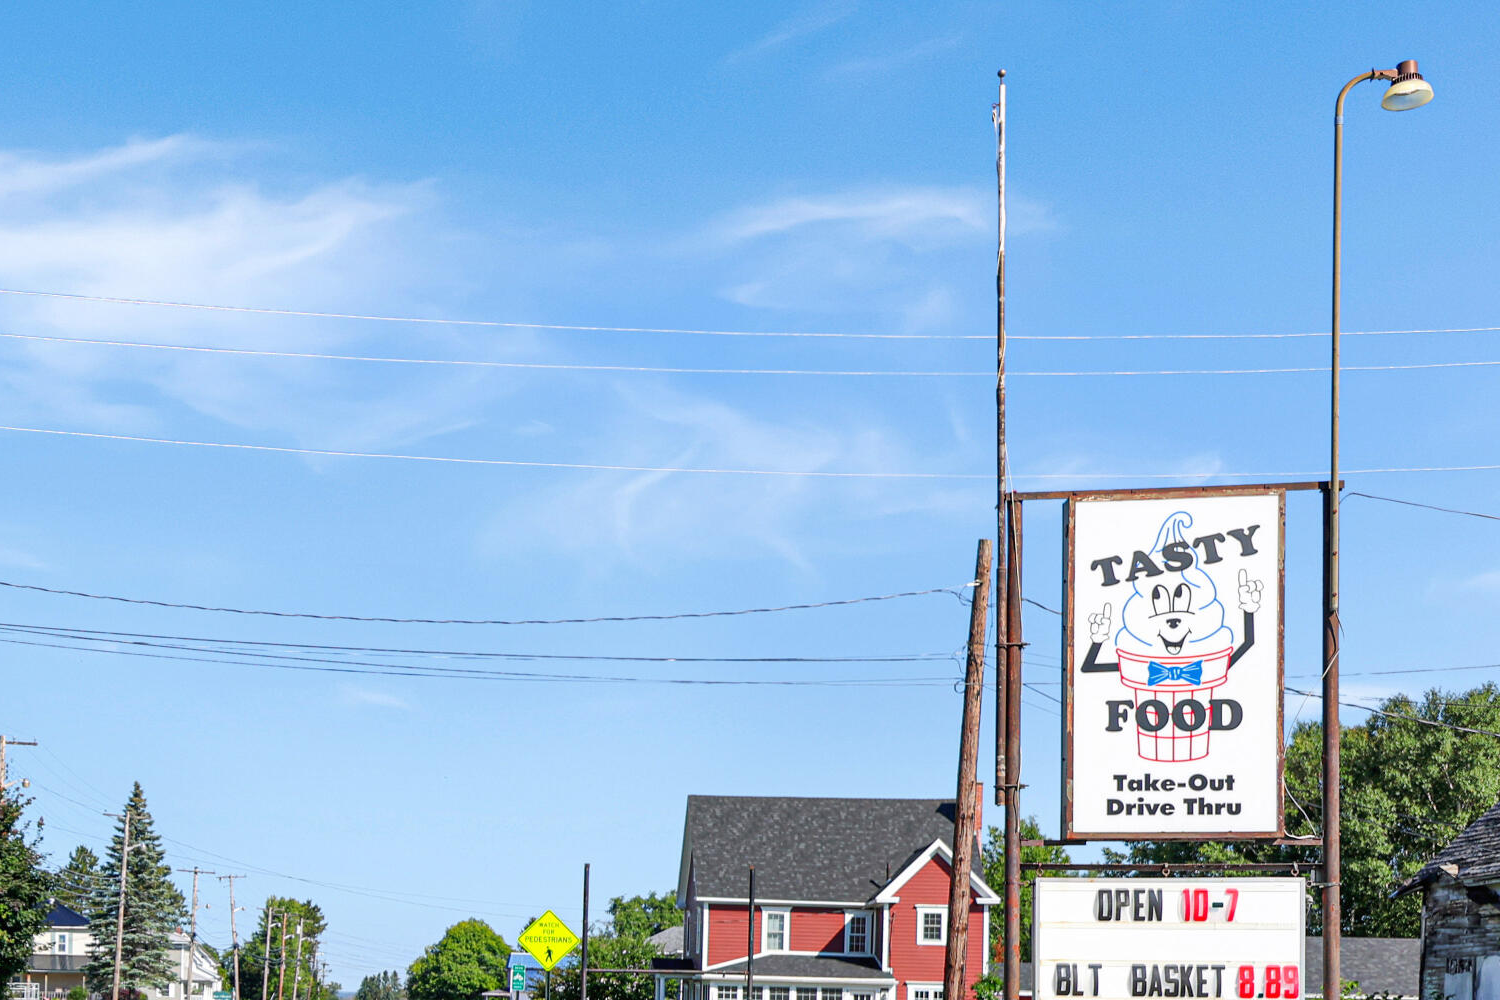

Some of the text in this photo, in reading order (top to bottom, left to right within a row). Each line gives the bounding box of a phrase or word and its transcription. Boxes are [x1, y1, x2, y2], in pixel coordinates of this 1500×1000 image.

[1091, 525, 1260, 587] TASTY
[1105, 699, 1243, 732] FOOD
[1113, 774, 1235, 792] Take-Out
[1106, 798, 1241, 816] Drive Thru
[1097, 888, 1239, 922] OPEN 10-7
[525, 936, 573, 944] PEDESTRIANS
[1055, 963, 1299, 999] BLT BASKET 8.89
